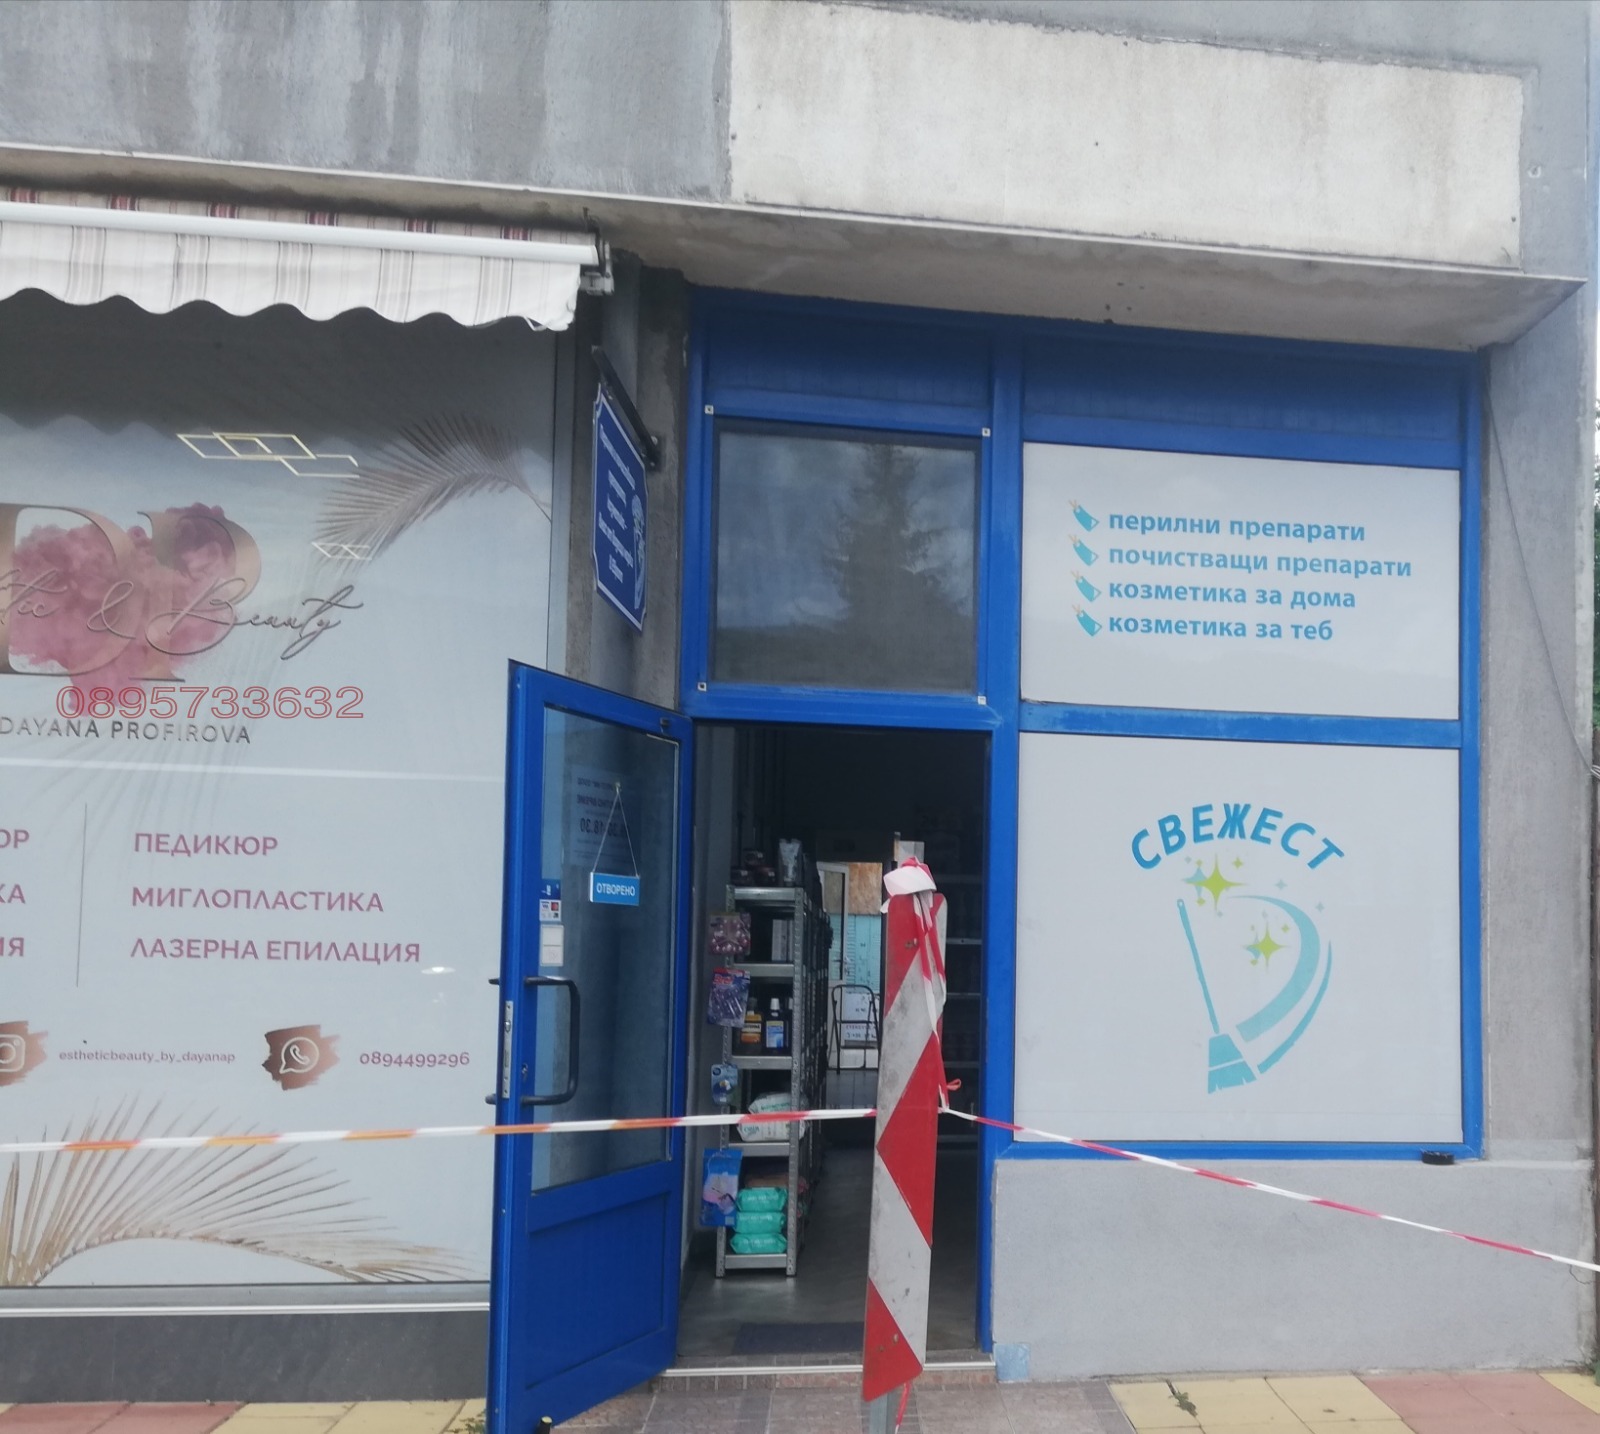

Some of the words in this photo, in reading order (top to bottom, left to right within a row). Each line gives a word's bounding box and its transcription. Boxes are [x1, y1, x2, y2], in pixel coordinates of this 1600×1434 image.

[1108, 513, 1221, 535] перилни
[1229, 520, 1366, 541] препарати
[1108, 547, 1269, 573] почистващи
[1276, 555, 1412, 578] препарати
[1108, 581, 1247, 604] козметика
[1255, 588, 1283, 605] за
[1290, 590, 1357, 610] дома
[145, 577, 364, 661] Beauty
[1108, 615, 1247, 638] козметика
[1255, 622, 1283, 639] за
[1290, 620, 1333, 641] теб
[0, 716, 100, 739] DAYANA
[110, 720, 251, 744] PROFIROVA
[134, 833, 279, 857] ПЕДИКЮР
[1131, 803, 1345, 870] СВЕЖЕСТ
[131, 887, 385, 912] МИГЛОПЛАСТИКА
[596, 882, 635, 897] ОТВОРЕНО
[130, 938, 260, 960] ЛАЗЕРНА
[266, 940, 421, 965] ЕПИЛАЦИЯ
[58, 1050, 236, 1064] estheticbeauty_by_dayanap
[359, 1051, 470, 1068] 0894499296
